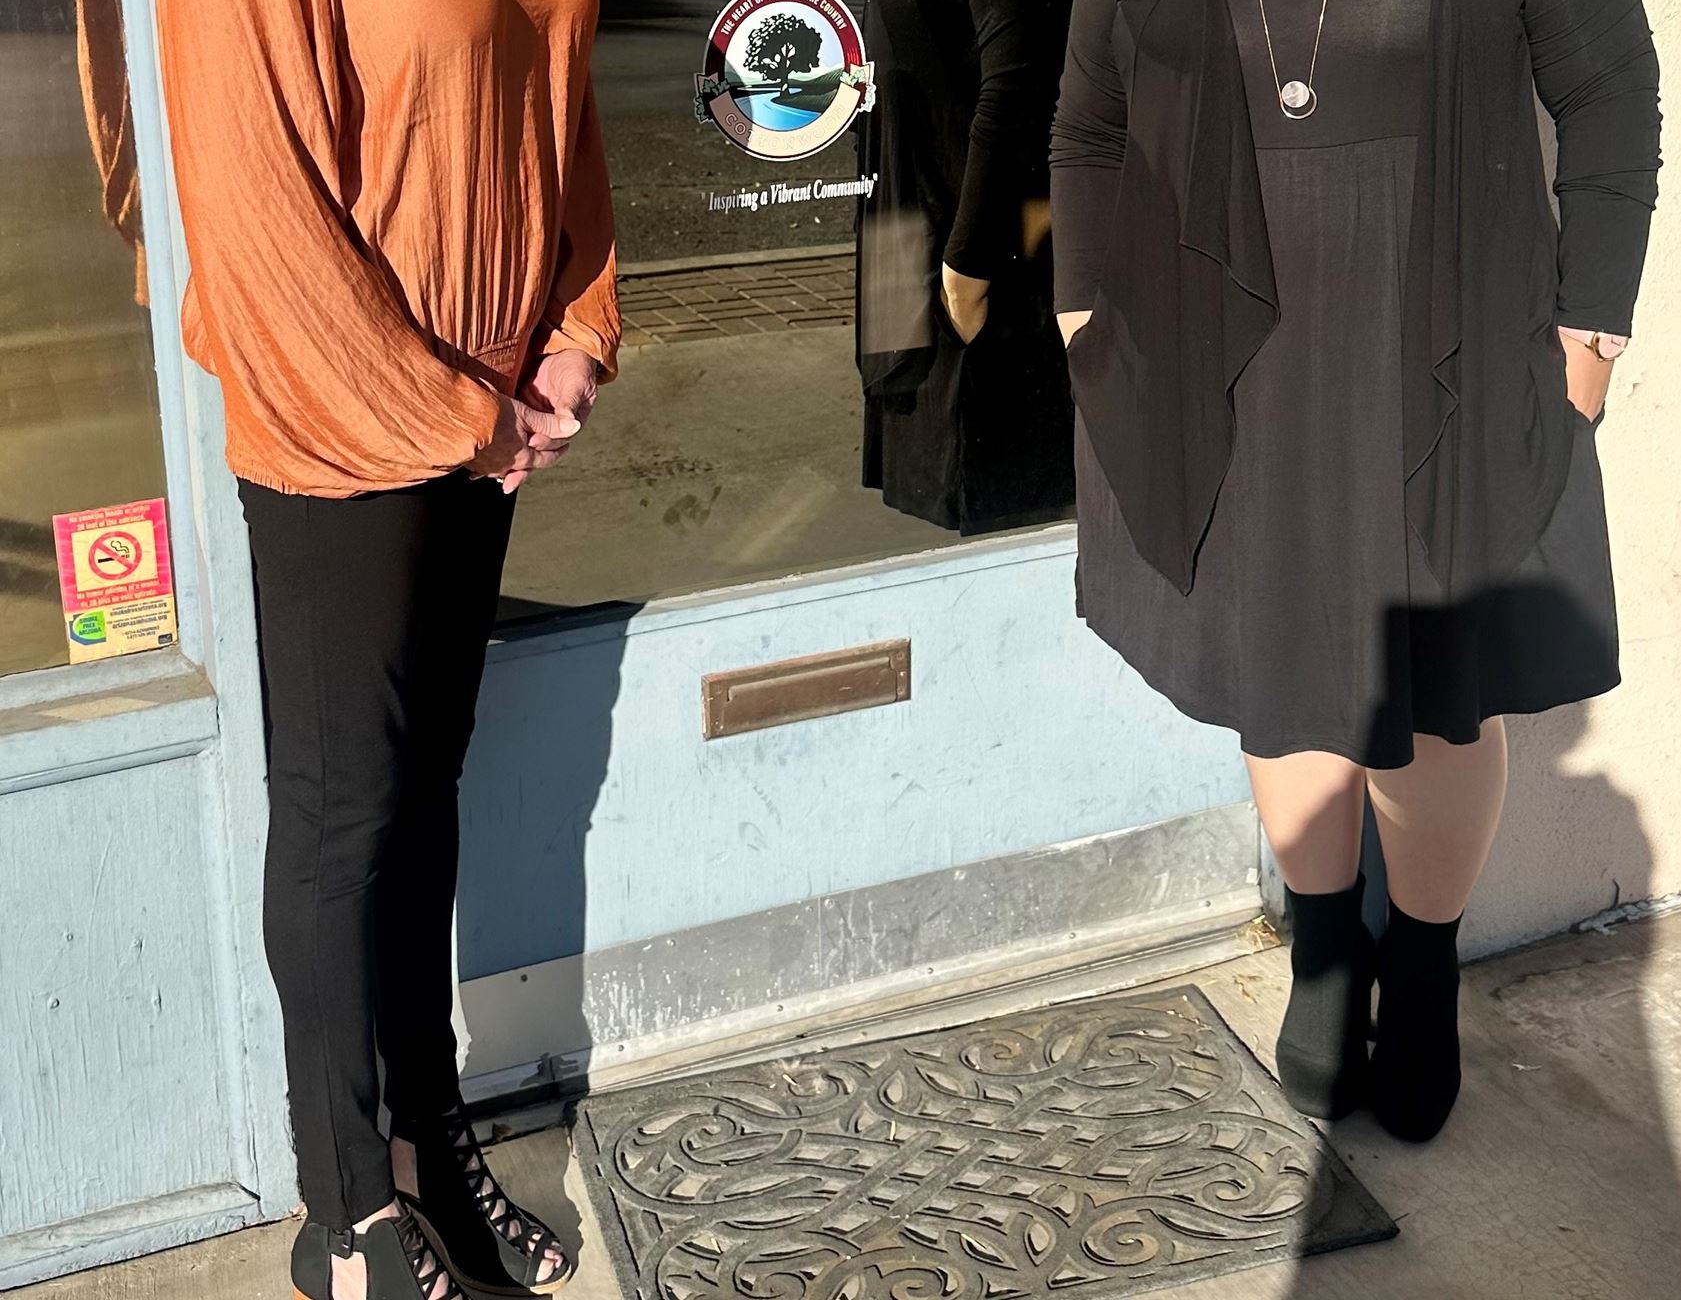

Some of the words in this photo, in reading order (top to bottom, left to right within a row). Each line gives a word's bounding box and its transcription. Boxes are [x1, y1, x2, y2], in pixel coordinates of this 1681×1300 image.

[721, 19, 736, 35] THE
[820, 0, 847, 30] COUNTRY
[760, 191, 768, 206] a
[770, 183, 811, 205] Vibrant
